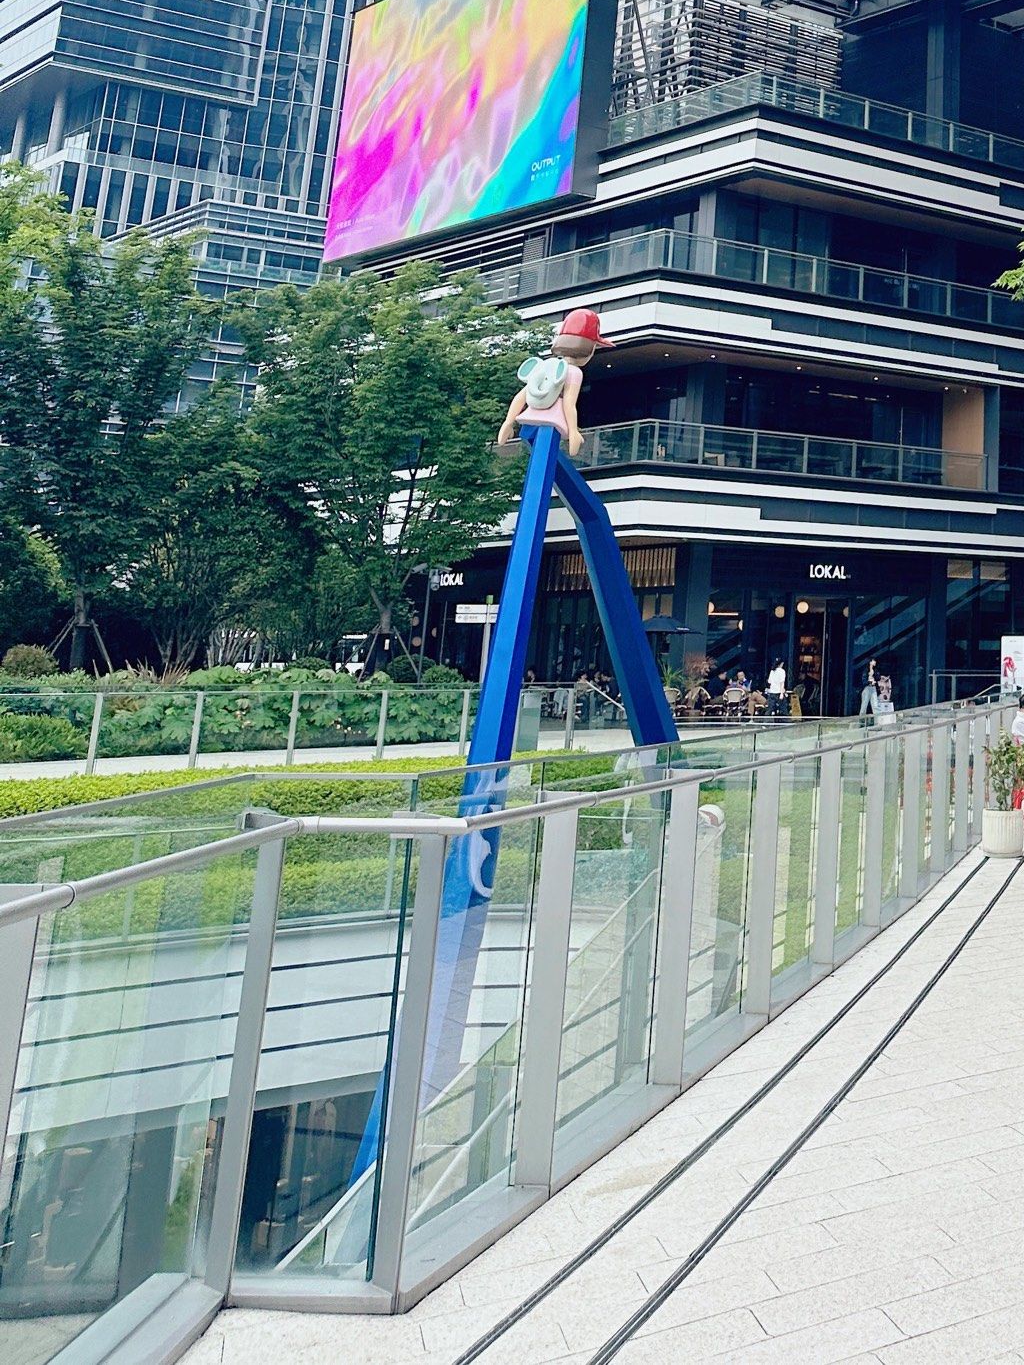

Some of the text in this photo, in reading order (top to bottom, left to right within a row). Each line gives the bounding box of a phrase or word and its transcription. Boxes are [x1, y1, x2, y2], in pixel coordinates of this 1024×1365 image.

[531, 154, 561, 172] OUTPUT
[809, 564, 847, 579] LOKAL
[440, 573, 464, 586] LOKAL
